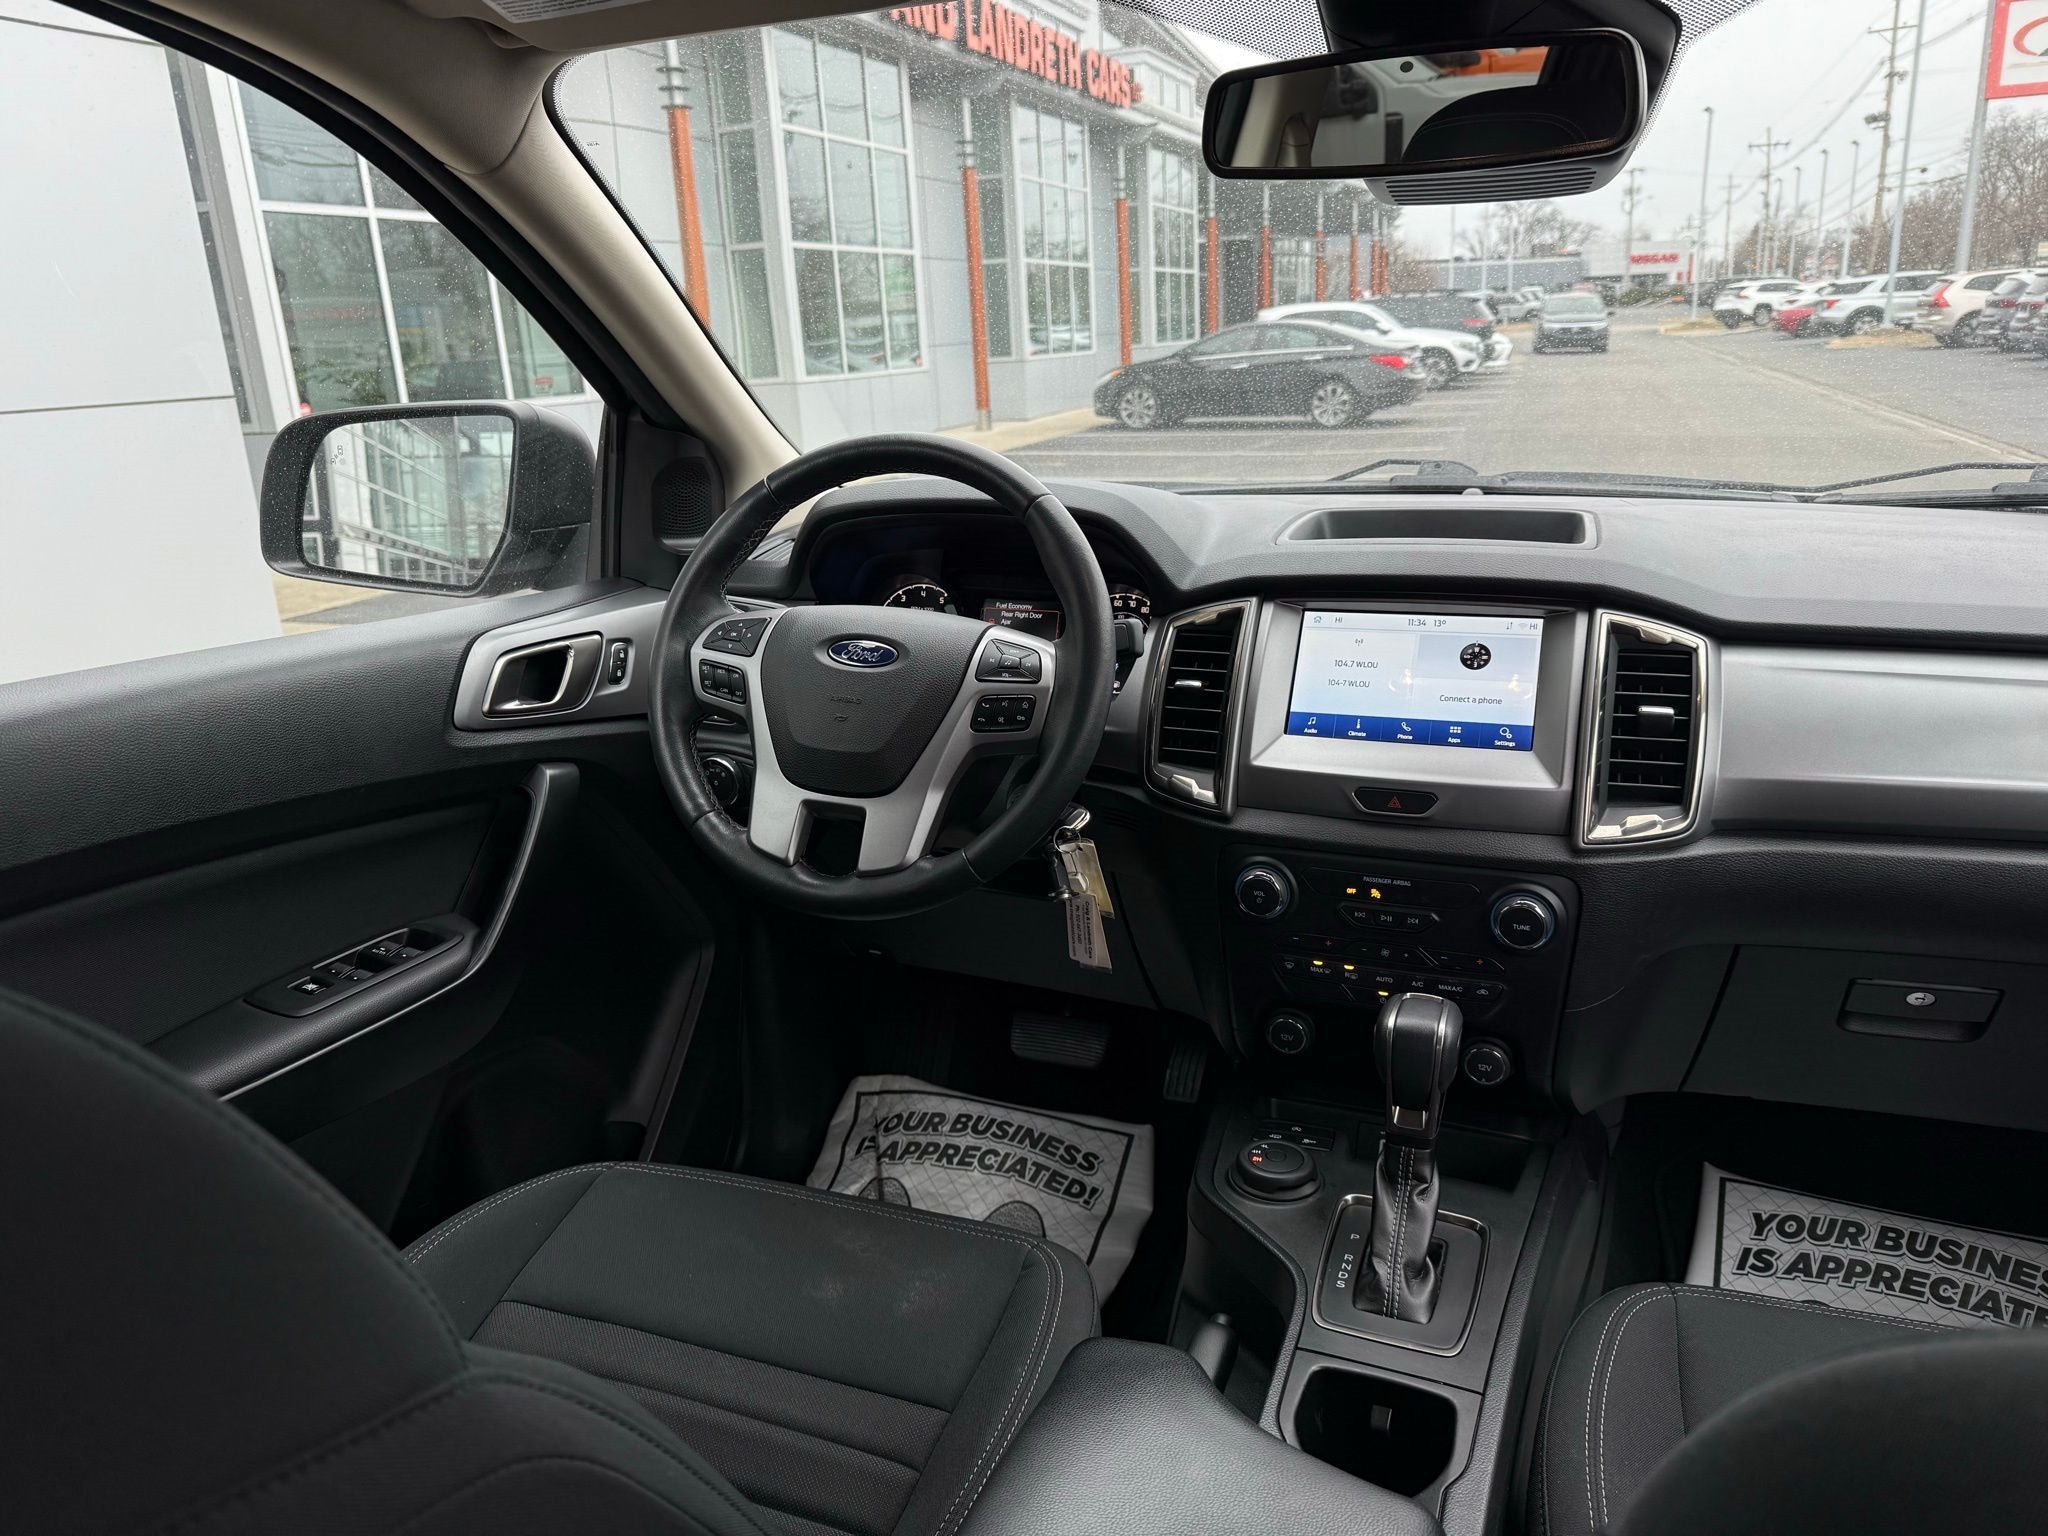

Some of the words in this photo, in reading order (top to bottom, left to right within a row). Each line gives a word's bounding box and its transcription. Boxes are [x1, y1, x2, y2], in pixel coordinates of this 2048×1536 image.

[964, 0, 1082, 91] LANDRETH
[1086, 48, 1132, 109] CARS
[1014, 612, 1029, 620] Right
[1407, 618, 1427, 627] 11:34
[841, 641, 884, 664] Ford
[1334, 659, 1355, 668] 104.7
[1356, 660, 1379, 669] WLOU
[1327, 679, 1347, 687] 104-7
[1347, 680, 1370, 688] WLOU
[1439, 695, 1471, 704] Connect
[1478, 696, 1503, 706] phone
[1363, 876, 1391, 885] PASSENGER
[1392, 879, 1412, 887] AIRBAG
[1310, 966, 1324, 974] MAX
[1411, 980, 1424, 988] A/C
[1451, 985, 1463, 993] A/C
[1280, 1034, 1294, 1042] 12V
[1477, 1063, 1492, 1072] 12V
[873, 1110, 947, 1134] YOUR
[948, 1112, 1101, 1174] BUSINESS
[854, 1135, 878, 1157] IS
[877, 1139, 1104, 1208] APPRECIATED!
[1750, 1211, 1868, 1248] YOUR
[1344, 1253, 1354, 1261] R
[1735, 1246, 1779, 1274] IS
[1341, 1262, 1351, 1271] N
[1338, 1271, 1348, 1279] D
[1336, 1280, 1346, 1288] S
